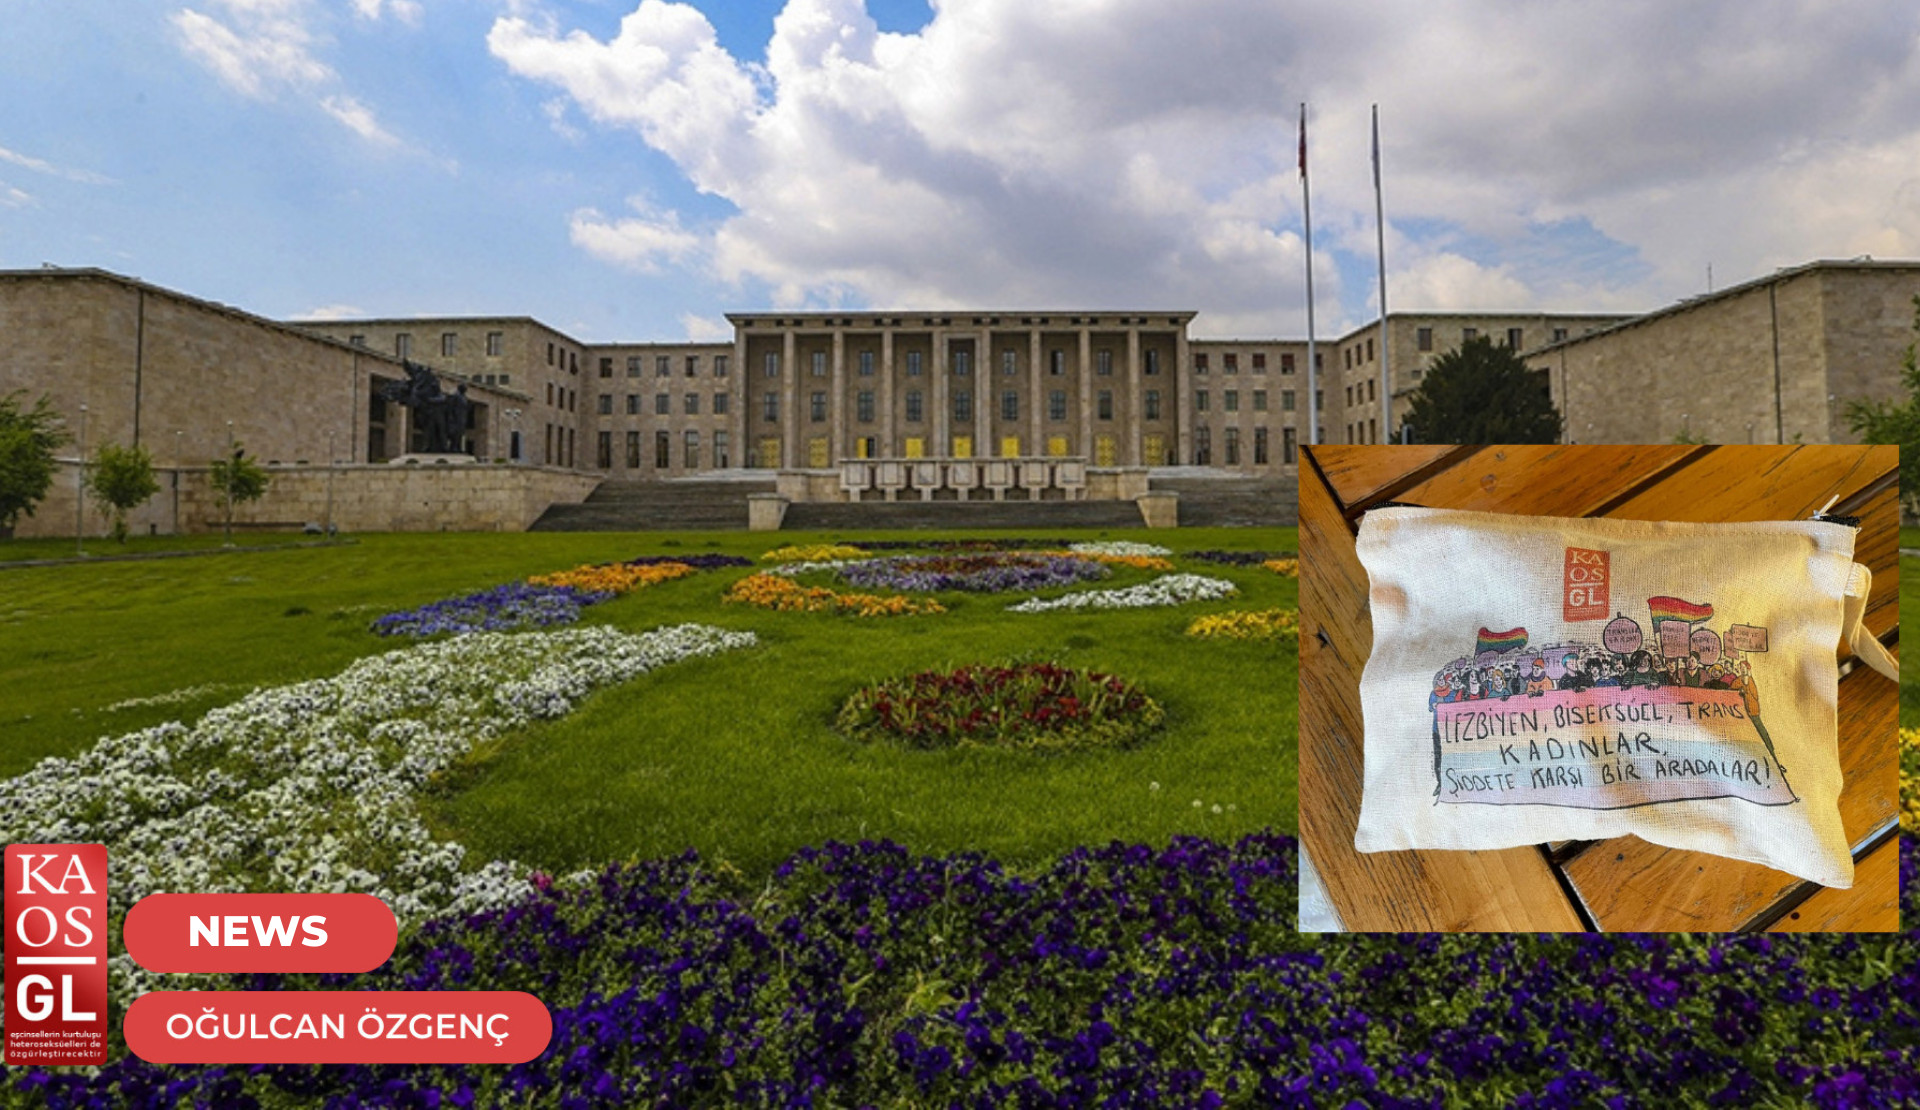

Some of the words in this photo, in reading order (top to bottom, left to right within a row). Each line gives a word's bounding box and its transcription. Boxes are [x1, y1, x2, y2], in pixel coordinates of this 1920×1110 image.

[1571, 551, 1603, 565] KA
[1570, 567, 1604, 581] OS
[1569, 588, 1603, 606] GL
[1445, 708, 1547, 743] LEZBİYEN,
[1677, 701, 1744, 719] TRANS
[1500, 732, 1667, 765] KADINLAR,
[1446, 768, 1515, 797] ŞİDDETE
[1531, 766, 1583, 789] KARŞI
[1602, 758, 1641, 784] BİR
[1656, 757, 1771, 789] ARADALAR!
